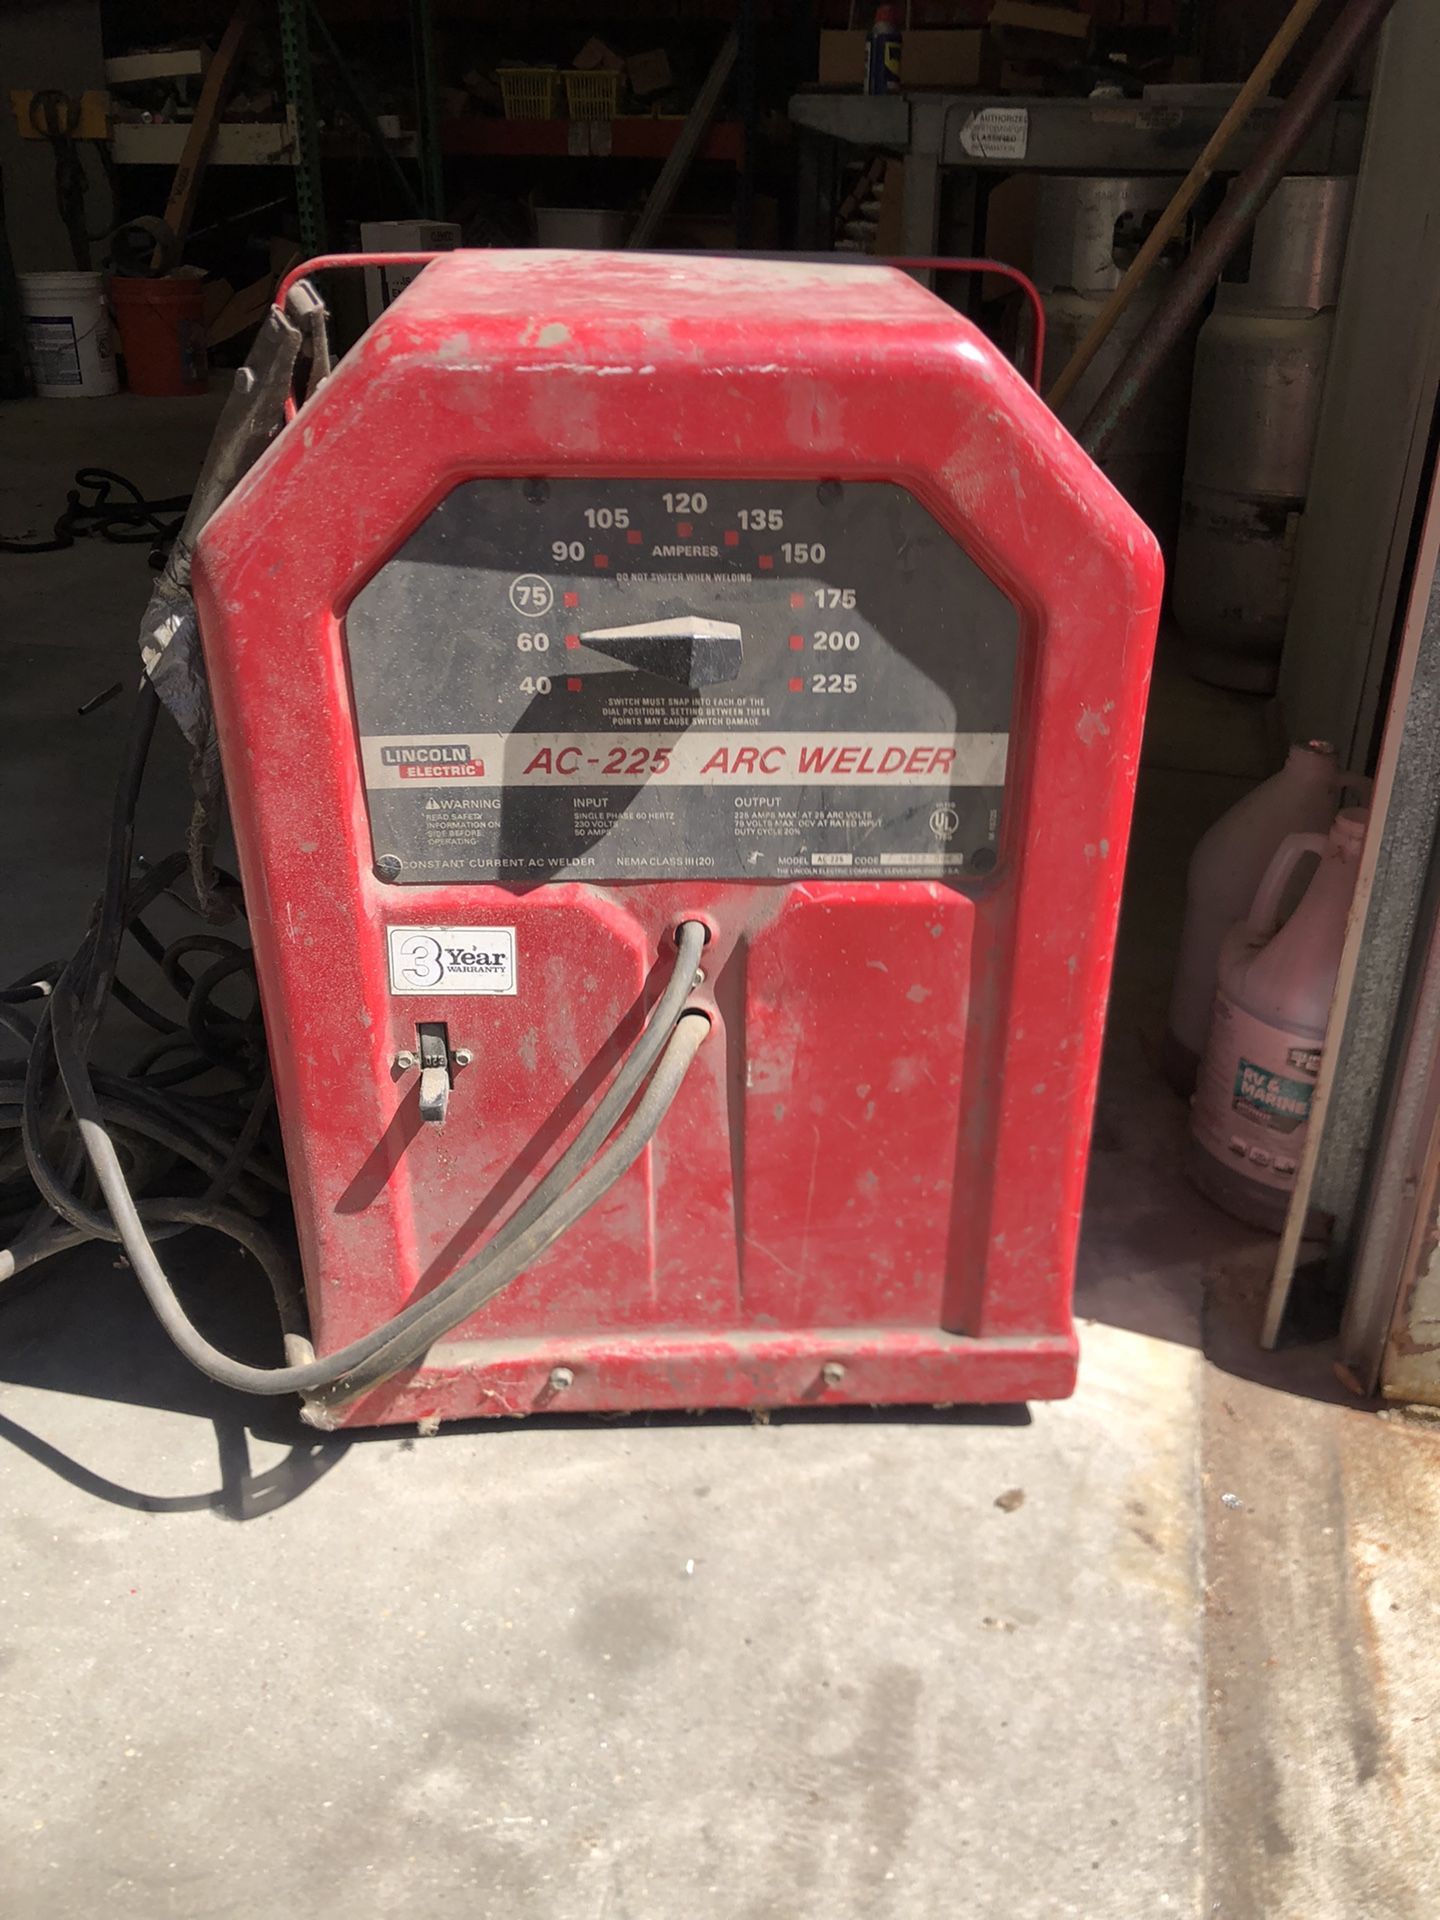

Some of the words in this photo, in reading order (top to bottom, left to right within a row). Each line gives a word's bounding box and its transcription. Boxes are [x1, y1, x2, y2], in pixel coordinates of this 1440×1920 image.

[662, 493, 708, 513] 120
[584, 509, 630, 529] 105
[737, 509, 784, 531] 135
[552, 541, 585, 562] 90
[652, 545, 719, 557] AMPERES
[781, 543, 826, 564] 150
[616, 573, 630, 583] DO
[631, 573, 650, 583] NOT
[651, 573, 685, 583] SWITCH
[686, 573, 712, 583] WHEN
[713, 573, 752, 583] WELDING
[516, 586, 547, 606] 75
[814, 589, 856, 609] 175
[517, 632, 549, 652] 60
[813, 631, 860, 651] 200
[519, 676, 552, 696] 40
[812, 674, 858, 694] 225
[608, 698, 640, 706] SWITCH
[642, 698, 665, 706] MUST
[668, 698, 690, 706] SNAP
[691, 698, 711, 706] INTO
[713, 698, 735, 706] EACH
[737, 698, 746, 706] OF
[750, 698, 764, 706] THE
[602, 707, 620, 716] DIAL
[670, 707, 703, 716] SETTING
[706, 707, 744, 716] BETWEEN
[746, 707, 771, 716] THESE
[612, 717, 642, 726] POINTS
[644, 717, 661, 726] MAY
[663, 717, 689, 726] CAUSE
[691, 717, 723, 726] SWITCH
[385, 748, 467, 763] LINCOLN
[523, 746, 672, 775] AC-225
[700, 746, 786, 775] ARC
[799, 746, 956, 775] WELDER
[440, 799, 501, 809] WARNING
[573, 798, 609, 808] INPUT
[734, 797, 782, 808] OUTPUT
[426, 813, 450, 821] READ
[574, 812, 605, 820] SINGLE
[606, 812, 634, 820] PHASE
[636, 812, 647, 820] 60
[648, 812, 675, 820] HERTZ
[751, 811, 776, 819] AMPS
[801, 811, 812, 819] AT
[826, 811, 844, 819] ARC
[845, 811, 873, 819] VOLTS
[426, 821, 486, 829] INFORMATION
[487, 821, 501, 829] ON
[574, 820, 591, 828] 230
[592, 820, 619, 828] VOLTS
[746, 819, 773, 828] VOLTS
[817, 819, 828, 828] AT
[829, 819, 857, 828] RATED
[858, 819, 883, 828] INPUT
[449, 830, 482, 838] BEFORE
[574, 828, 586, 836] 50
[587, 828, 612, 836] AMPS
[734, 827, 756, 836] DUTY
[756, 827, 782, 836] CYCLE
[403, 859, 465, 869] CONSTANT
[468, 858, 525, 868] CURRENT
[528, 858, 545, 867] AC
[548, 858, 596, 867] WELDER
[616, 856, 647, 867] NEMA
[649, 856, 683, 867] CLASS
[777, 856, 810, 865] MODEL
[854, 856, 880, 865] CODE
[400, 935, 444, 987] 3
[445, 948, 506, 966] Year
[446, 965, 507, 974] WARRANTY
[1243, 1067, 1266, 1086] RV
[1241, 1080, 1308, 1115] MARINE
